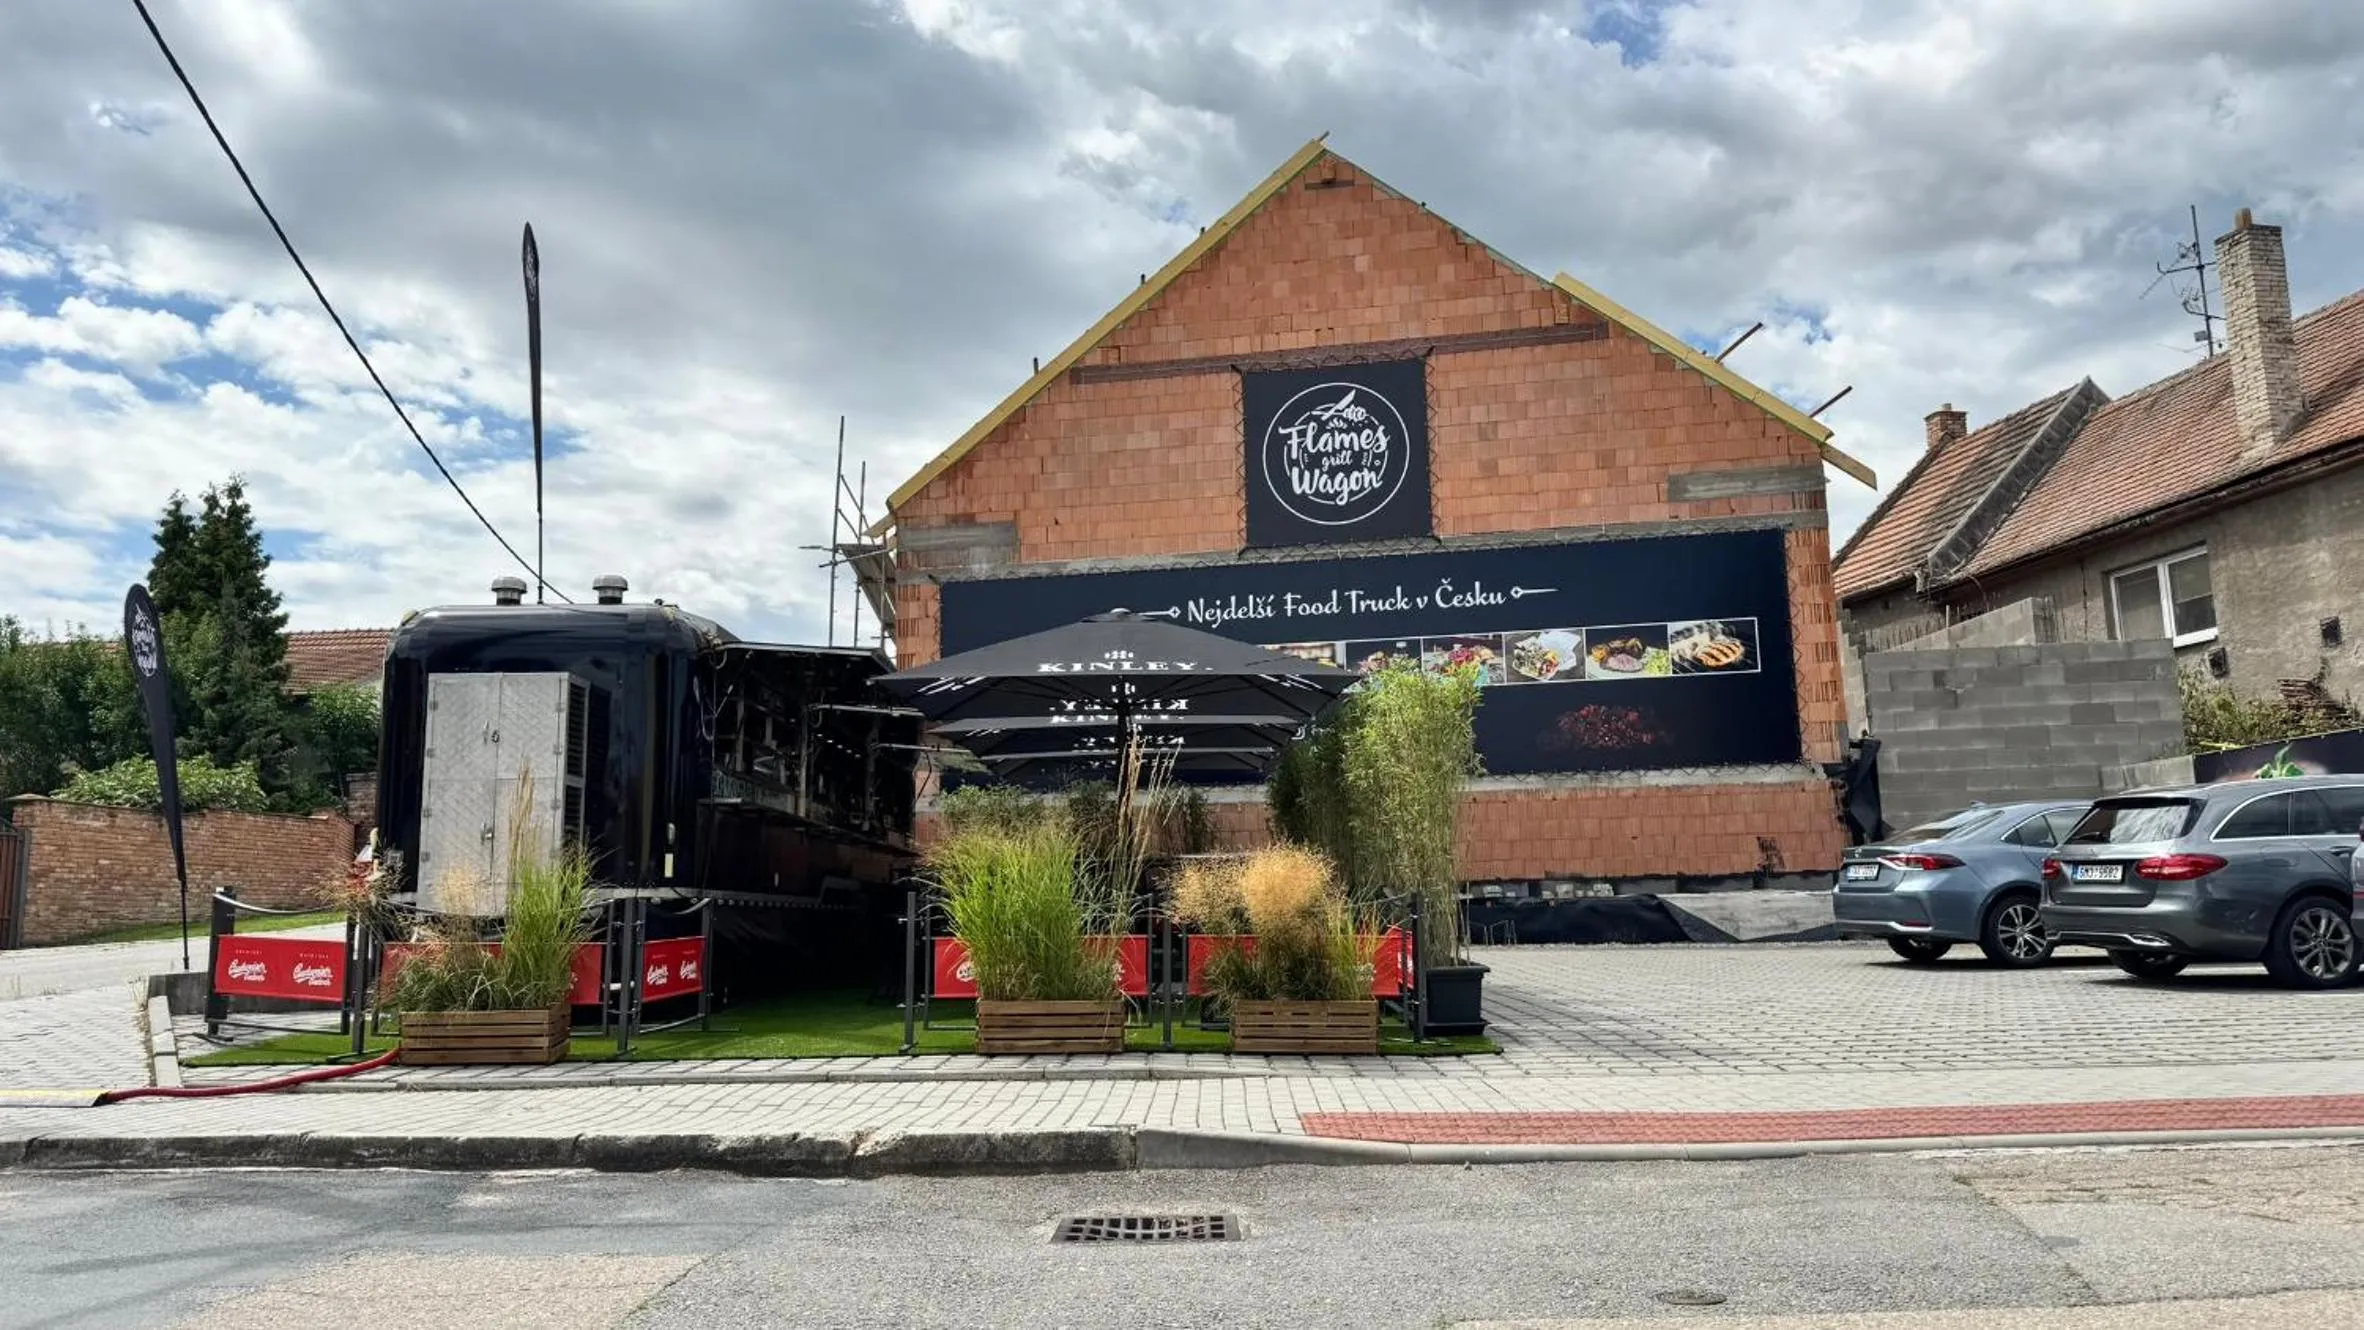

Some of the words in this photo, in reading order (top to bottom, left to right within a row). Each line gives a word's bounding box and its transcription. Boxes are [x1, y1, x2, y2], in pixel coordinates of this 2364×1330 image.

[1278, 421, 1391, 460] Flames
[1322, 451, 1353, 472] grill
[1291, 466, 1383, 506] Wagon
[1187, 592, 1276, 628] Nejdelší
[1284, 589, 1342, 617] Food
[1345, 585, 1413, 616] Truck
[1416, 594, 1429, 611] v
[1434, 578, 1507, 609] Česku
